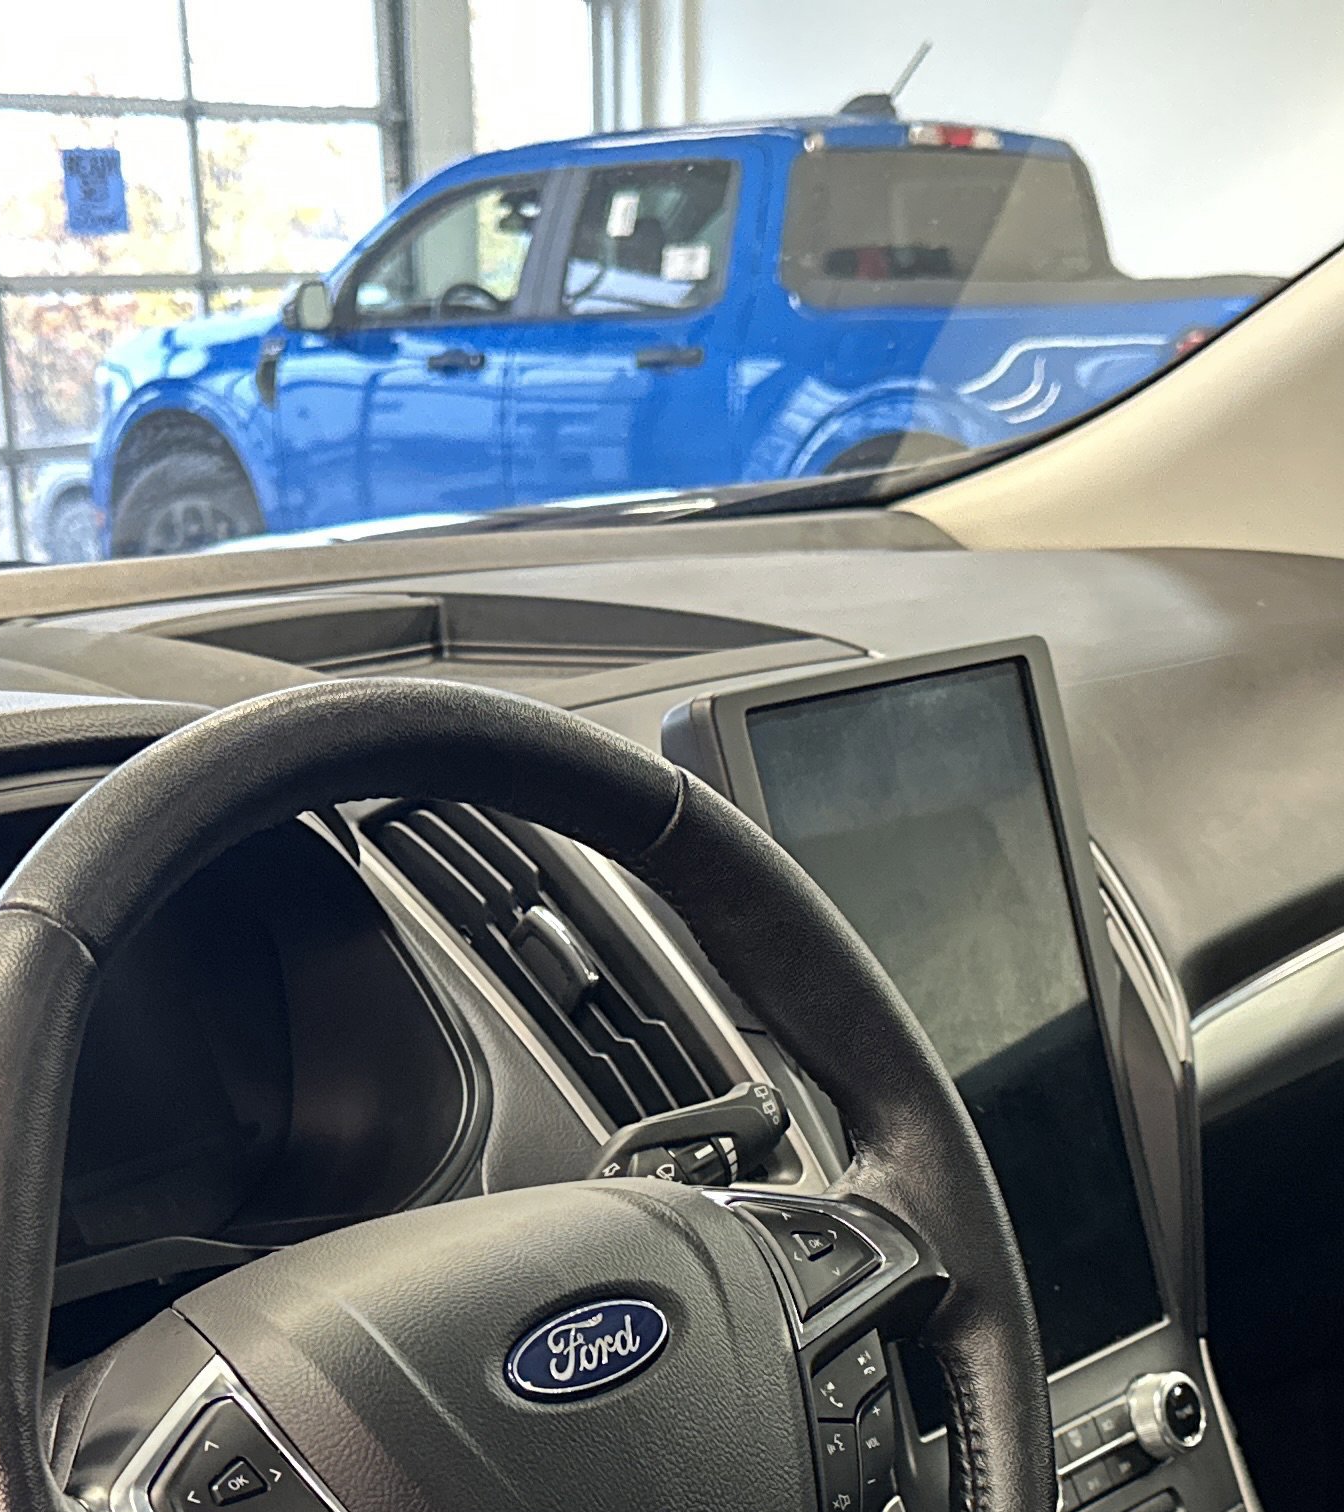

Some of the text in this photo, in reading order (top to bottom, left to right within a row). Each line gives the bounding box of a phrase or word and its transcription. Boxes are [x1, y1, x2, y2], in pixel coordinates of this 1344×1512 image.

[807, 1238, 824, 1249] OK
[547, 1312, 641, 1381] Ford
[227, 1474, 250, 1491] OK
